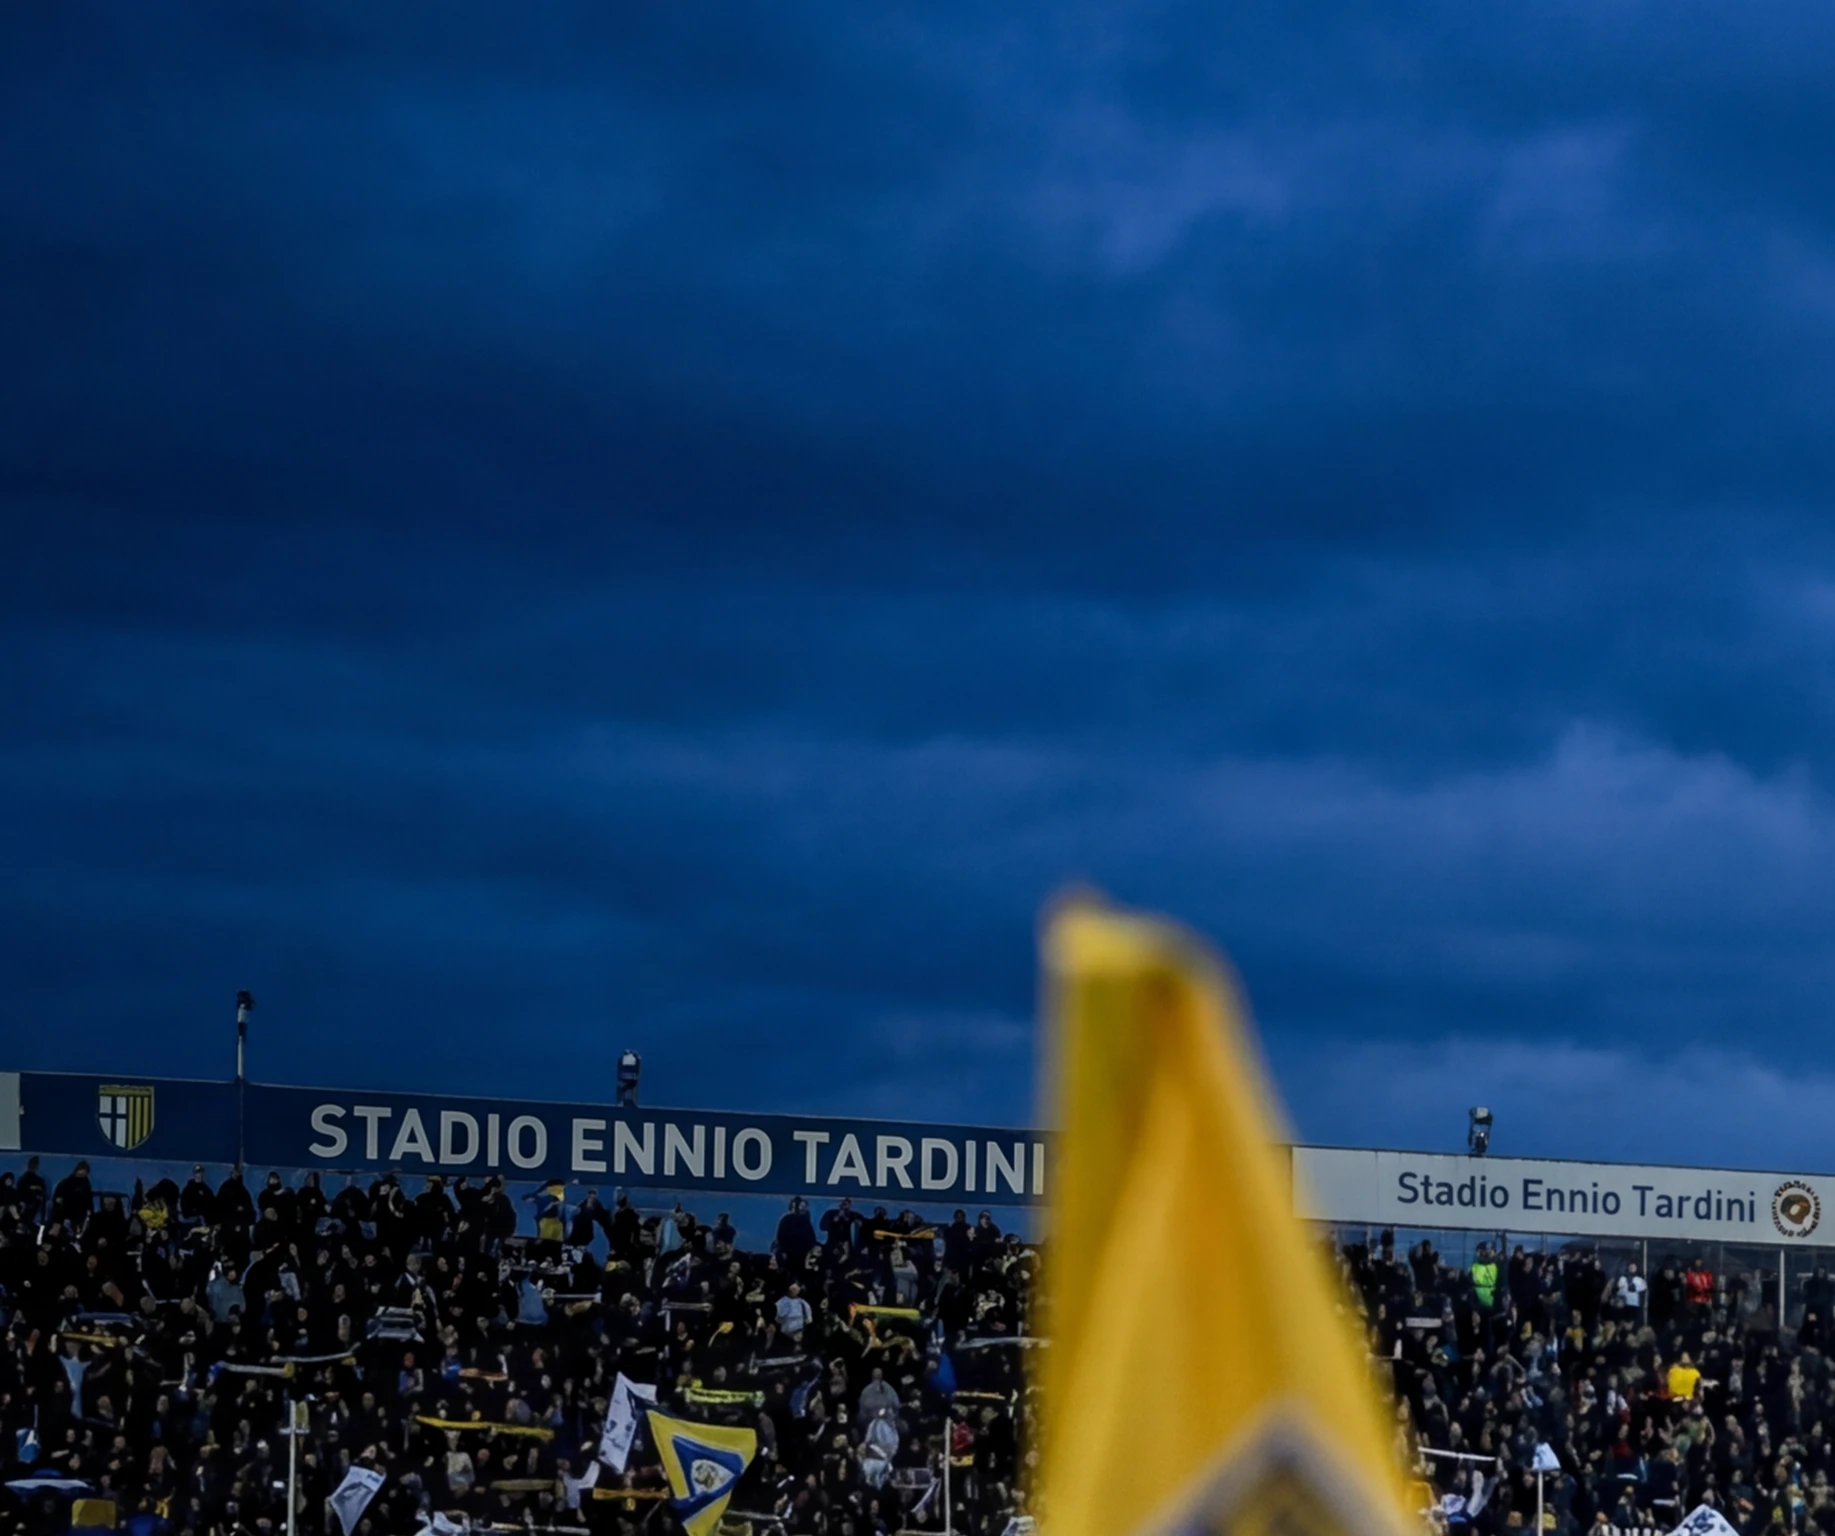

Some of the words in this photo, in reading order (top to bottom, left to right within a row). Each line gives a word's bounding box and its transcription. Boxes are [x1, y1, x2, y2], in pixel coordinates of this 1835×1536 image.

[308, 1104, 548, 1170] STADIO
[571, 1118, 773, 1182] ENNIO
[793, 1129, 1045, 1196] TARDINI
[1397, 1171, 1509, 1210] Stadio
[1521, 1179, 1621, 1217] Ennio
[1631, 1184, 1757, 1224] Tardini
